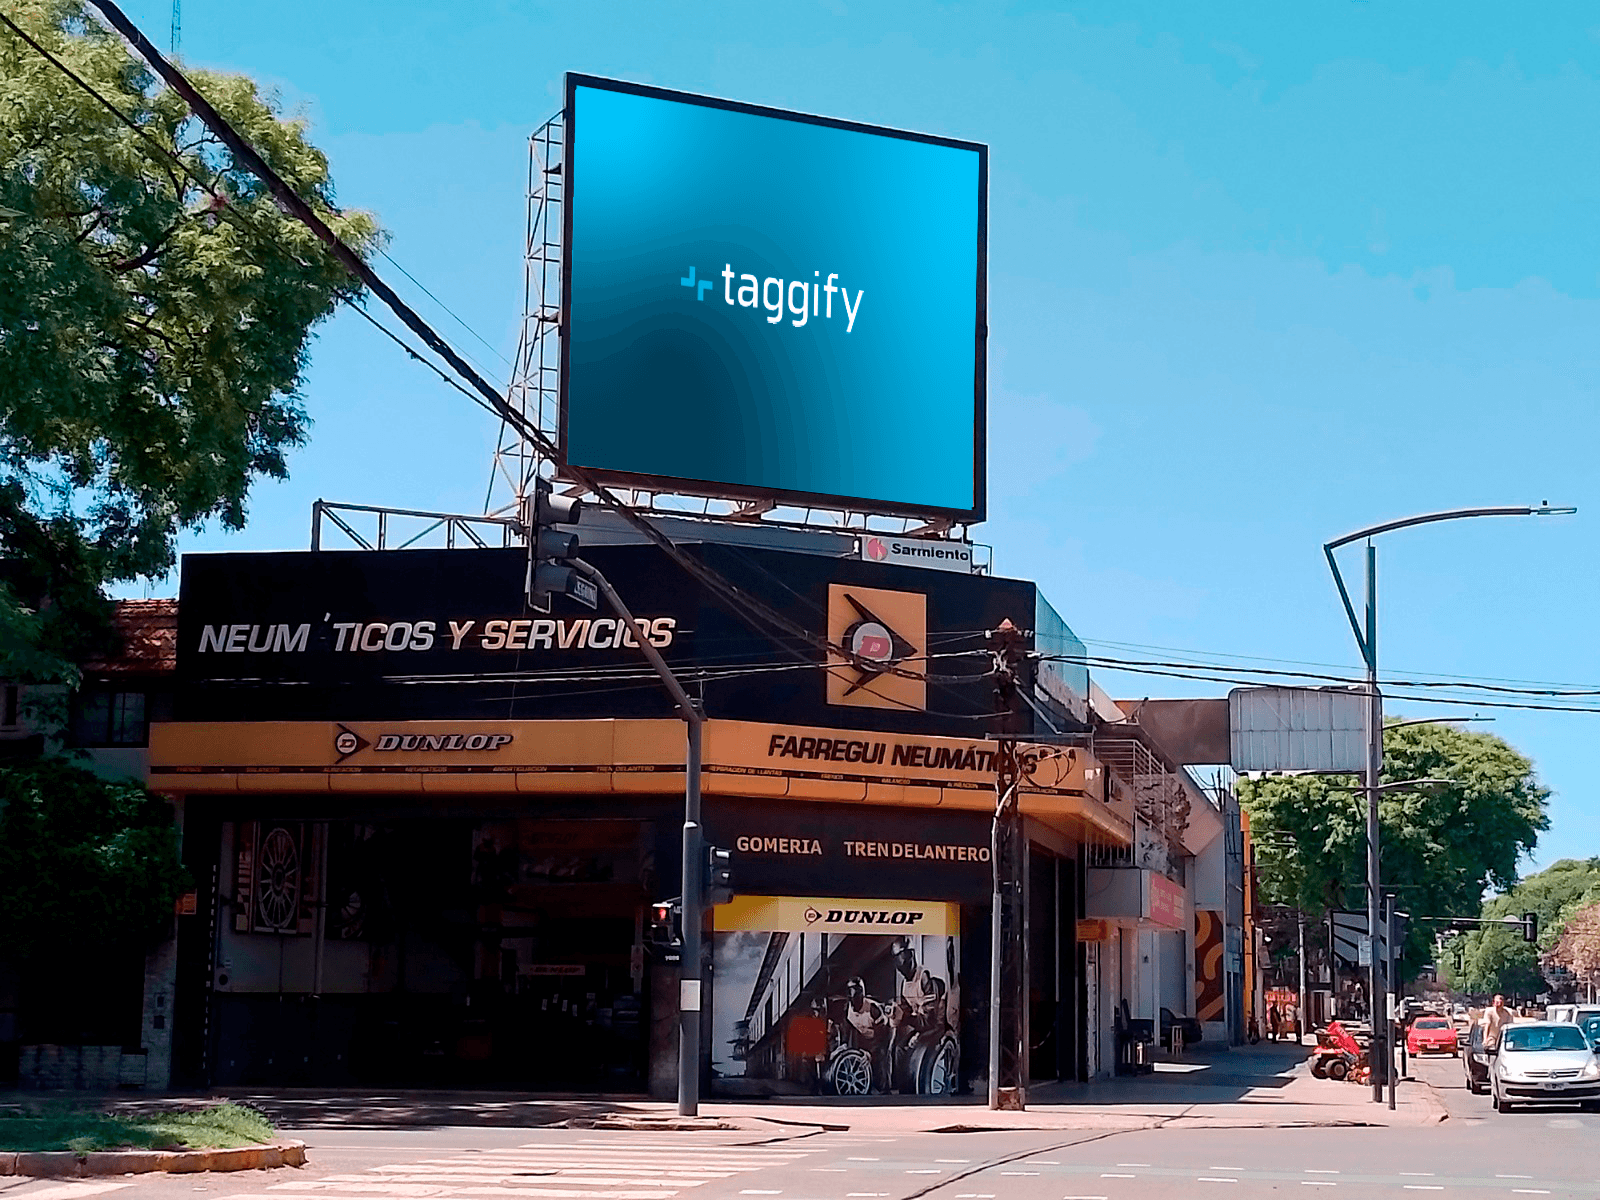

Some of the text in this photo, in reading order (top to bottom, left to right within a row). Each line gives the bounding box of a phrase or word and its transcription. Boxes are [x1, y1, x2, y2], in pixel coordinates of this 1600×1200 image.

[721, 263, 865, 333] taggify
[891, 543, 969, 561] Sarmiento
[448, 620, 475, 650] Y
[481, 618, 676, 650] SERVICIOS
[374, 734, 514, 751] DUNLOP
[768, 734, 1037, 775] FARREGUI NEUMÁTIS
[736, 836, 823, 855] GOMERIA
[843, 841, 991, 862] TREN DELANTERO
[824, 910, 924, 925] DUNLOP
